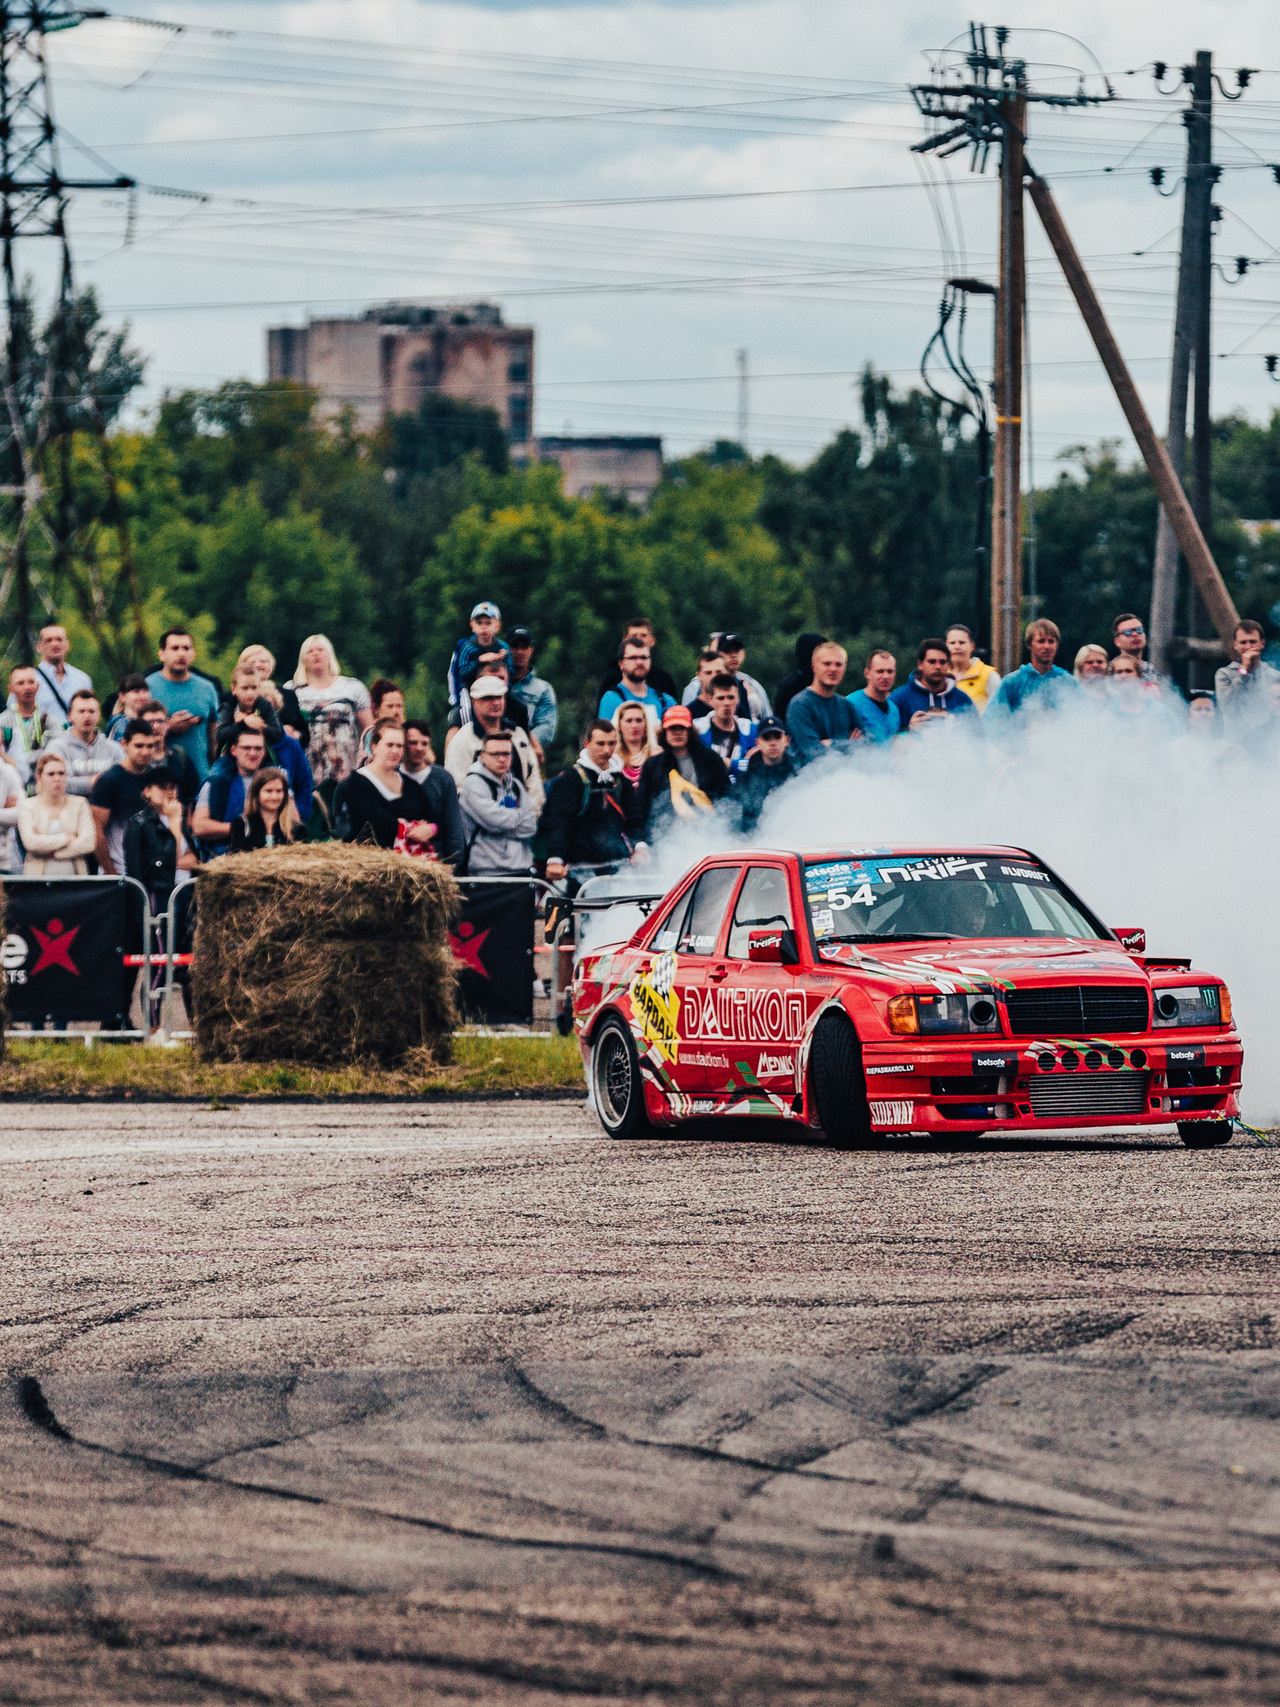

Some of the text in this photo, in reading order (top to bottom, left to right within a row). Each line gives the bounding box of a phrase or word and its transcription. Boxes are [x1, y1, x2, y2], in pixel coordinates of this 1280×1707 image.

[1001, 866, 1050, 882] #LVDRIFT
[828, 884, 877, 910] 54
[634, 982, 677, 1059] BARDAHL
[977, 1058, 1006, 1066] betsafe
[1171, 1051, 1195, 1059] betsafe
[866, 1065, 914, 1075] RIEPASMAKROL.LV
[869, 1101, 914, 1125] SIDEWAY
